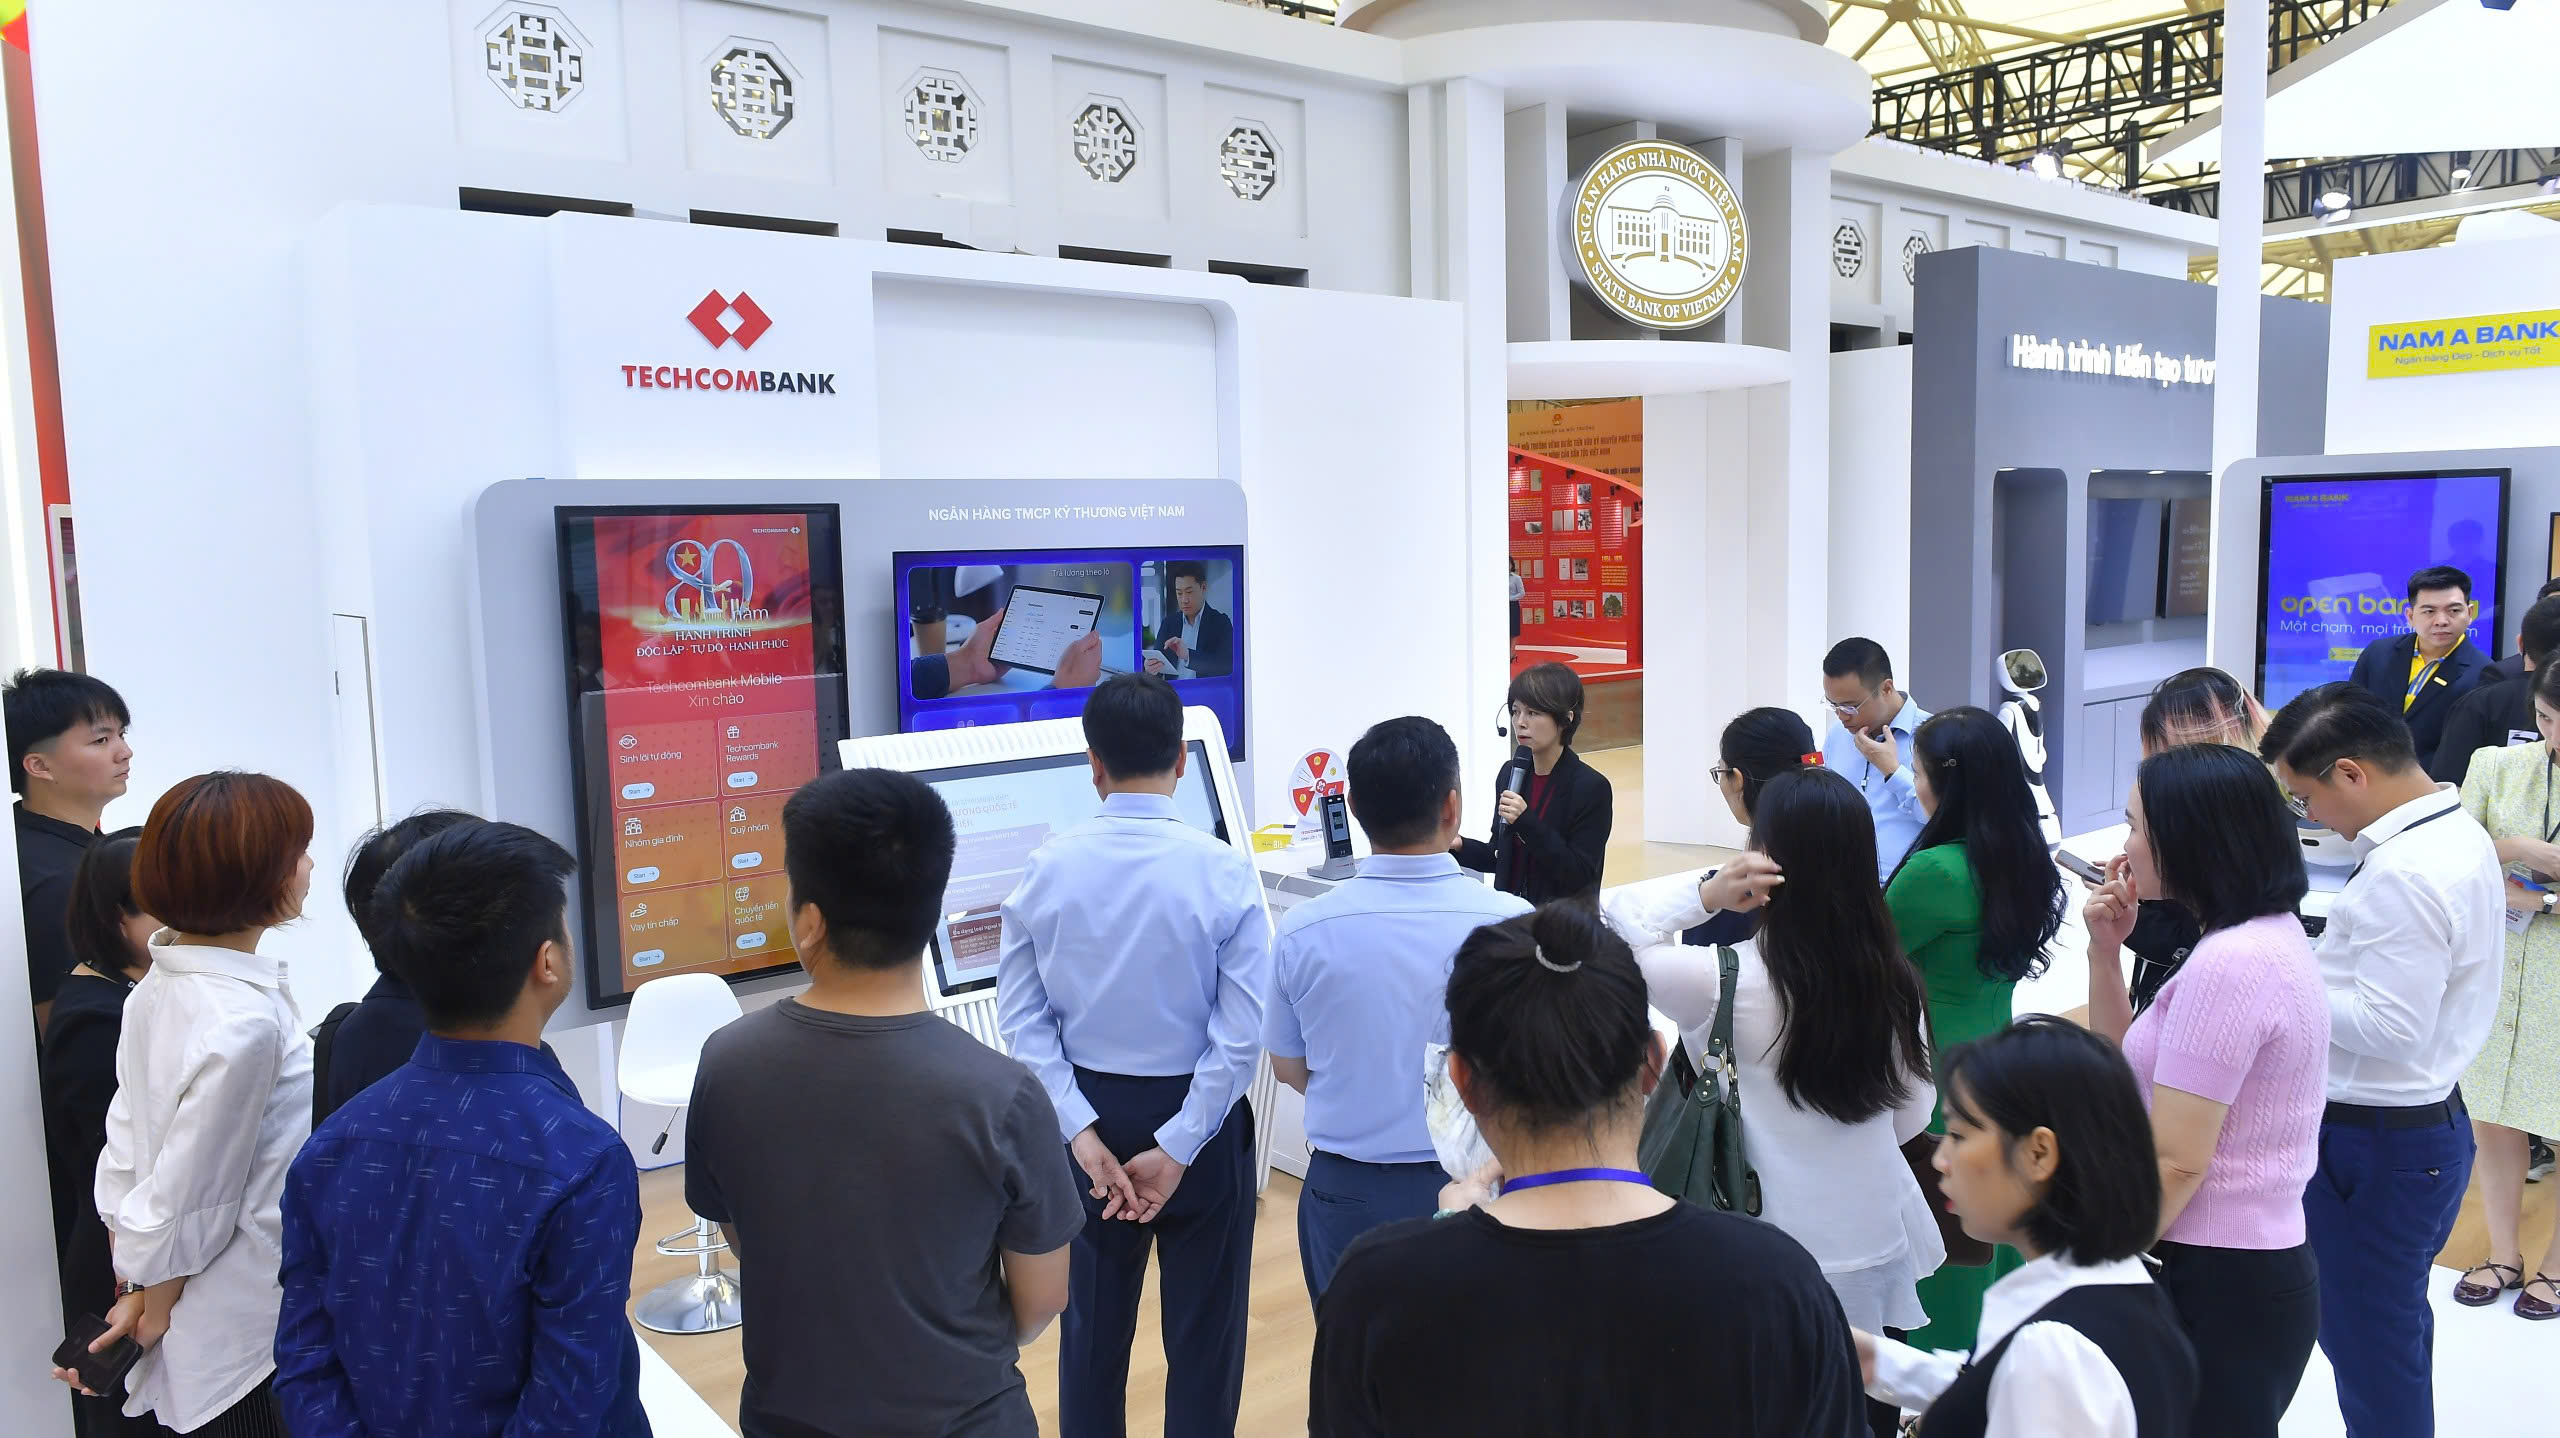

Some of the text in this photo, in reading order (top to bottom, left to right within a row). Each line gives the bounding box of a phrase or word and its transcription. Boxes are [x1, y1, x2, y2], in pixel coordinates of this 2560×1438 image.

[1581, 149, 1743, 263] NGÂN HÀNG NHÀ NƯỚC VIỆT NAM
[1592, 262, 1733, 319] STATE BANK OF VIETNAM
[2379, 320, 2560, 351] NAM A BANK
[2184, 354, 2216, 384] tươ
[621, 365, 836, 394] TECHCOMBANK
[928, 504, 1185, 521] NGÂN HÀNG TMCP KỸ THƯƠNG VIỆT NAM
[2280, 596, 2352, 617] open
[2280, 620, 2307, 634] Một
[2361, 623, 2388, 636] mọi
[636, 638, 789, 658] ĐỘC LẬP TỰ DO HẠNH PHÚC
[645, 672, 782, 694] Techcombank Mobile
[688, 692, 744, 708] Xin chào
[726, 741, 779, 753] Techcombank
[619, 752, 638, 764] Sinh
[660, 751, 682, 761] động
[726, 752, 759, 763] Rewards
[730, 823, 769, 836] Quỹ nhóm
[625, 833, 684, 849] Nhóm gia đình
[734, 904, 764, 916] Chuyển
[630, 917, 679, 932] Vay tín chấp
[735, 913, 754, 925] quốc
[638, 955, 651, 963] Start
